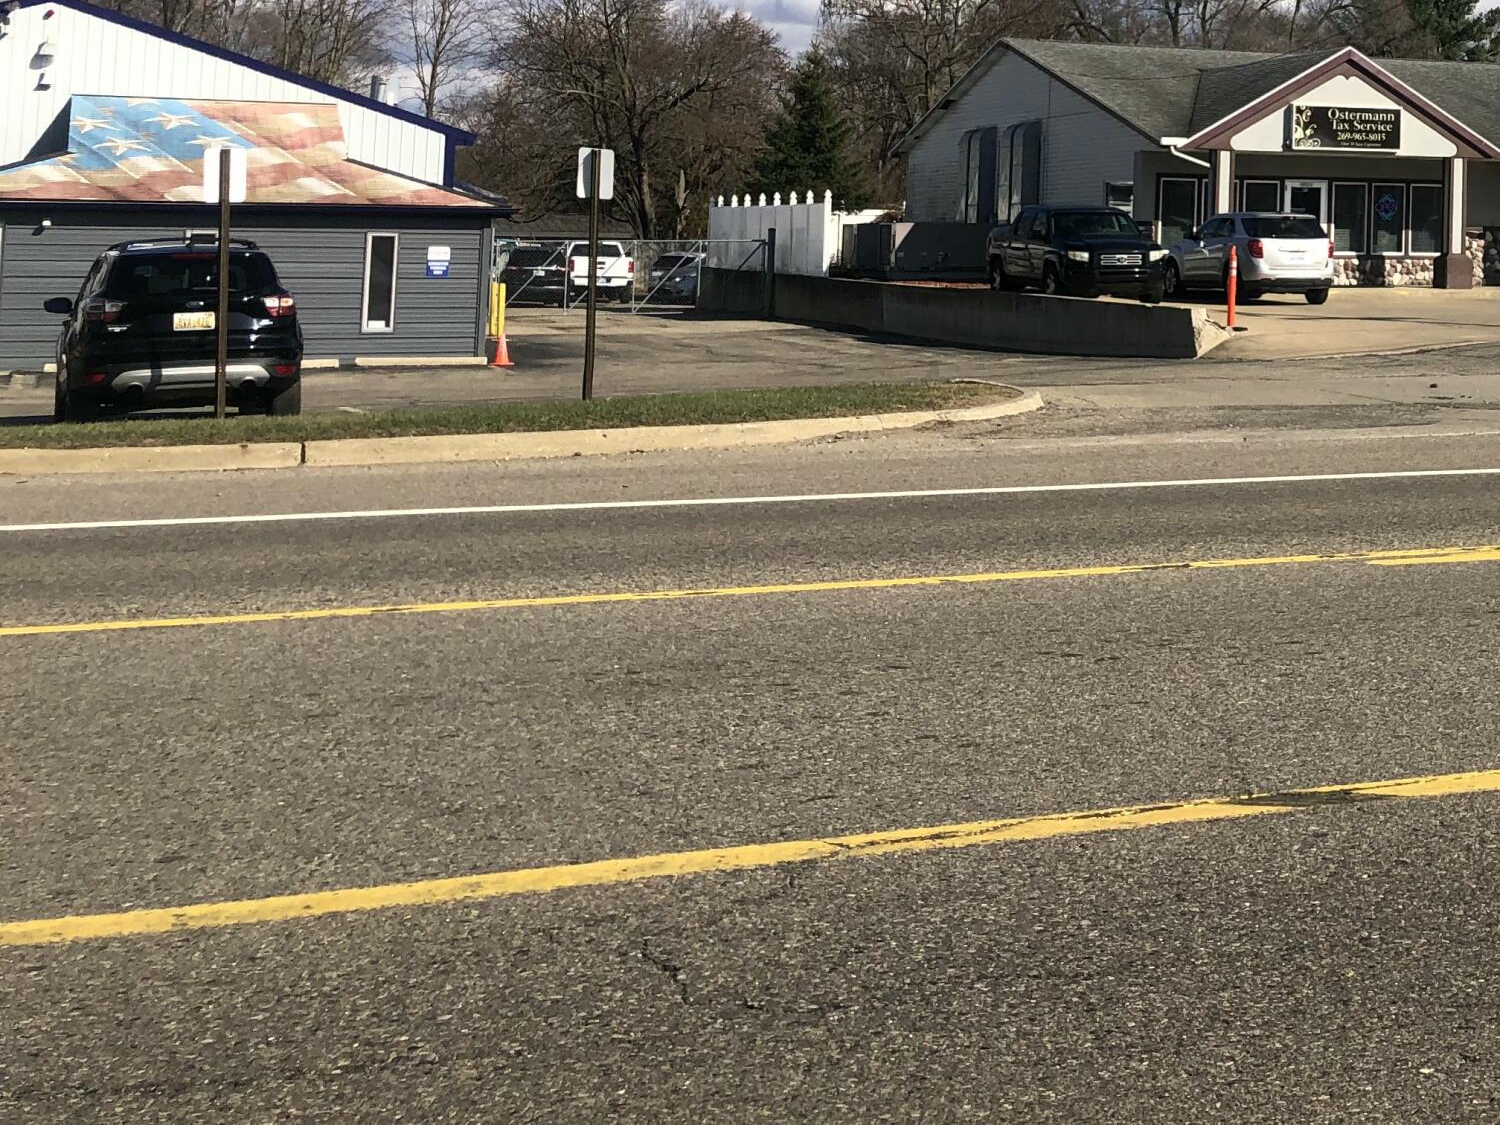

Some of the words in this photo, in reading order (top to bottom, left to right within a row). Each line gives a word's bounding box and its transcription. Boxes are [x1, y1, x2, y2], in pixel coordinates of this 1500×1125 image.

[1327, 108, 1395, 122] Ostermann
[1330, 119, 1350, 130] Tax
[1353, 120, 1393, 132] Service
[1337, 132, 1387, 141] 269-965-8015
